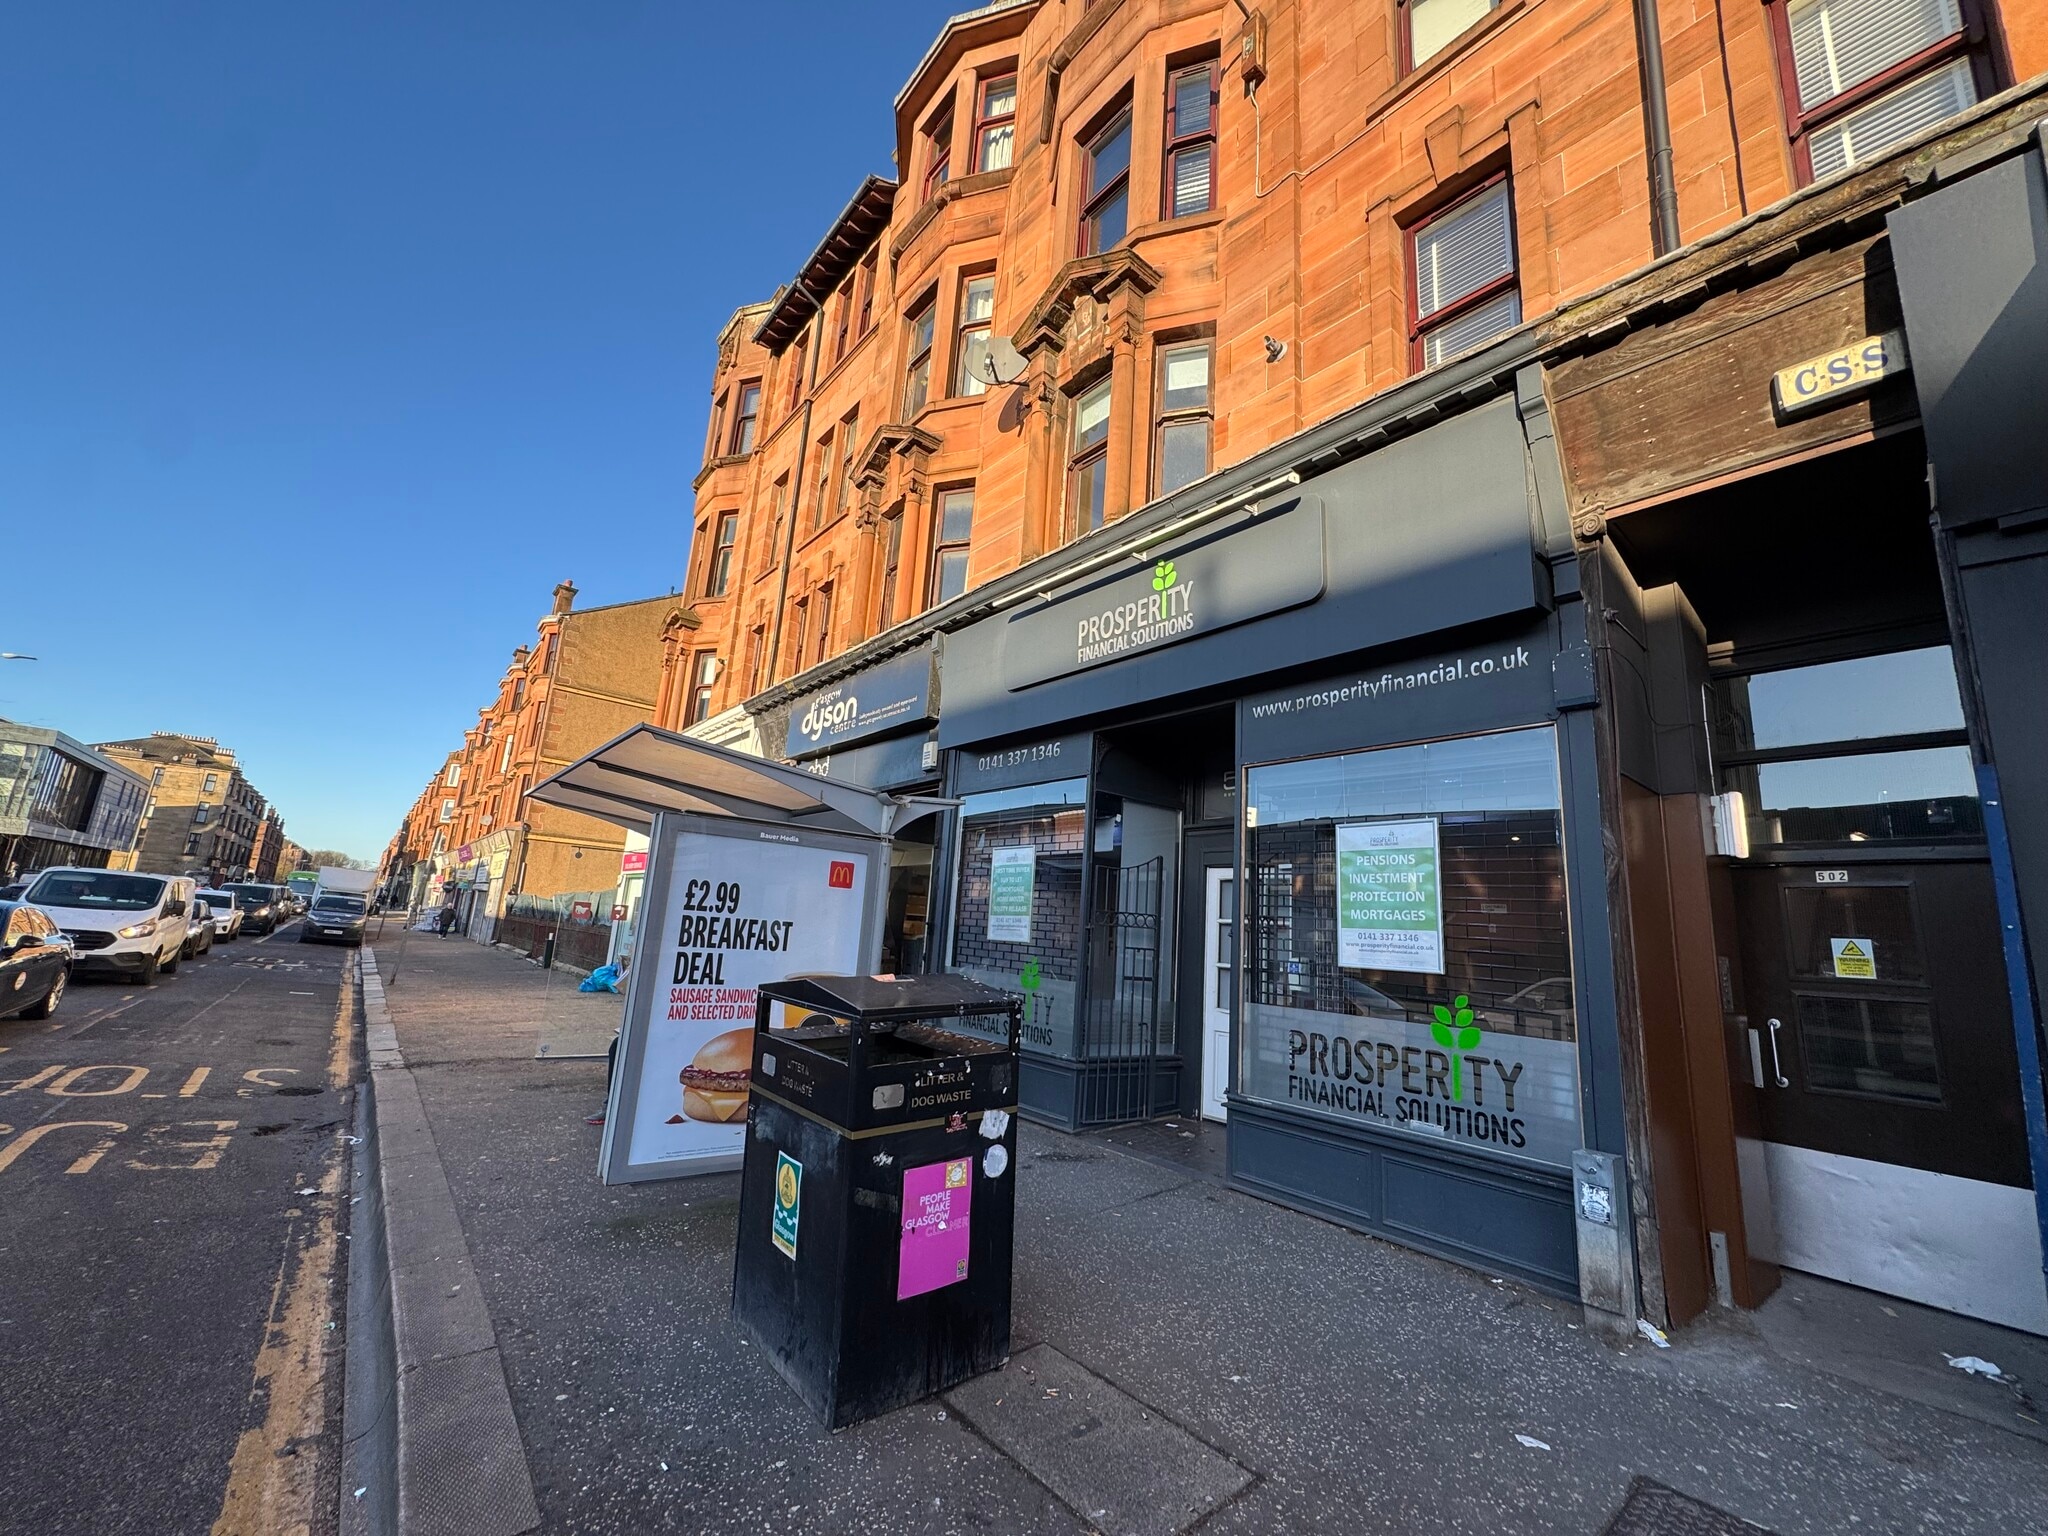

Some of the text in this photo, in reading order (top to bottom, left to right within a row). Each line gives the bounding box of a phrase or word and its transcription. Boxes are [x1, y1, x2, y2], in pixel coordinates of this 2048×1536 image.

[1078, 581, 1194, 646] PROSPERITY
[1078, 613, 1194, 664] FINANCIAL SOLUTIONS
[1252, 646, 1529, 719] www.prosperityfinancial.co.uk
[802, 697, 857, 741] dyson
[830, 718, 857, 735] centre
[978, 742, 1061, 771] 0141 337 1346
[760, 831, 799, 843] Bauer Media
[1356, 854, 1416, 866] PENSIONS
[1349, 872, 1425, 884] INVESTMENT
[683, 878, 741, 914] £2.99
[1350, 891, 1425, 903] PROTECTION
[1351, 909, 1426, 921] MORTGAGES
[678, 914, 793, 951] BREAKFAST
[1357, 932, 1419, 942] 0141 337 1346
[672, 951, 725, 985] DEAL
[670, 988, 757, 1004] SAUSAGE SANDWIC
[667, 1004, 689, 1021] AND
[690, 1005, 735, 1020] SELECTED
[959, 1014, 1000, 1035] FINANCIAL
[920, 1072, 956, 1087] LITTER
[1289, 1029, 1523, 1113] PROSPERITY
[911, 1090, 972, 1109] DOG WASTE
[1289, 1075, 1527, 1149] FINANCIAL SOLUTIONS
[920, 1189, 952, 1206] PEOPLE
[925, 1200, 951, 1215] MAKE
[905, 1210, 950, 1230] GLASGOW
